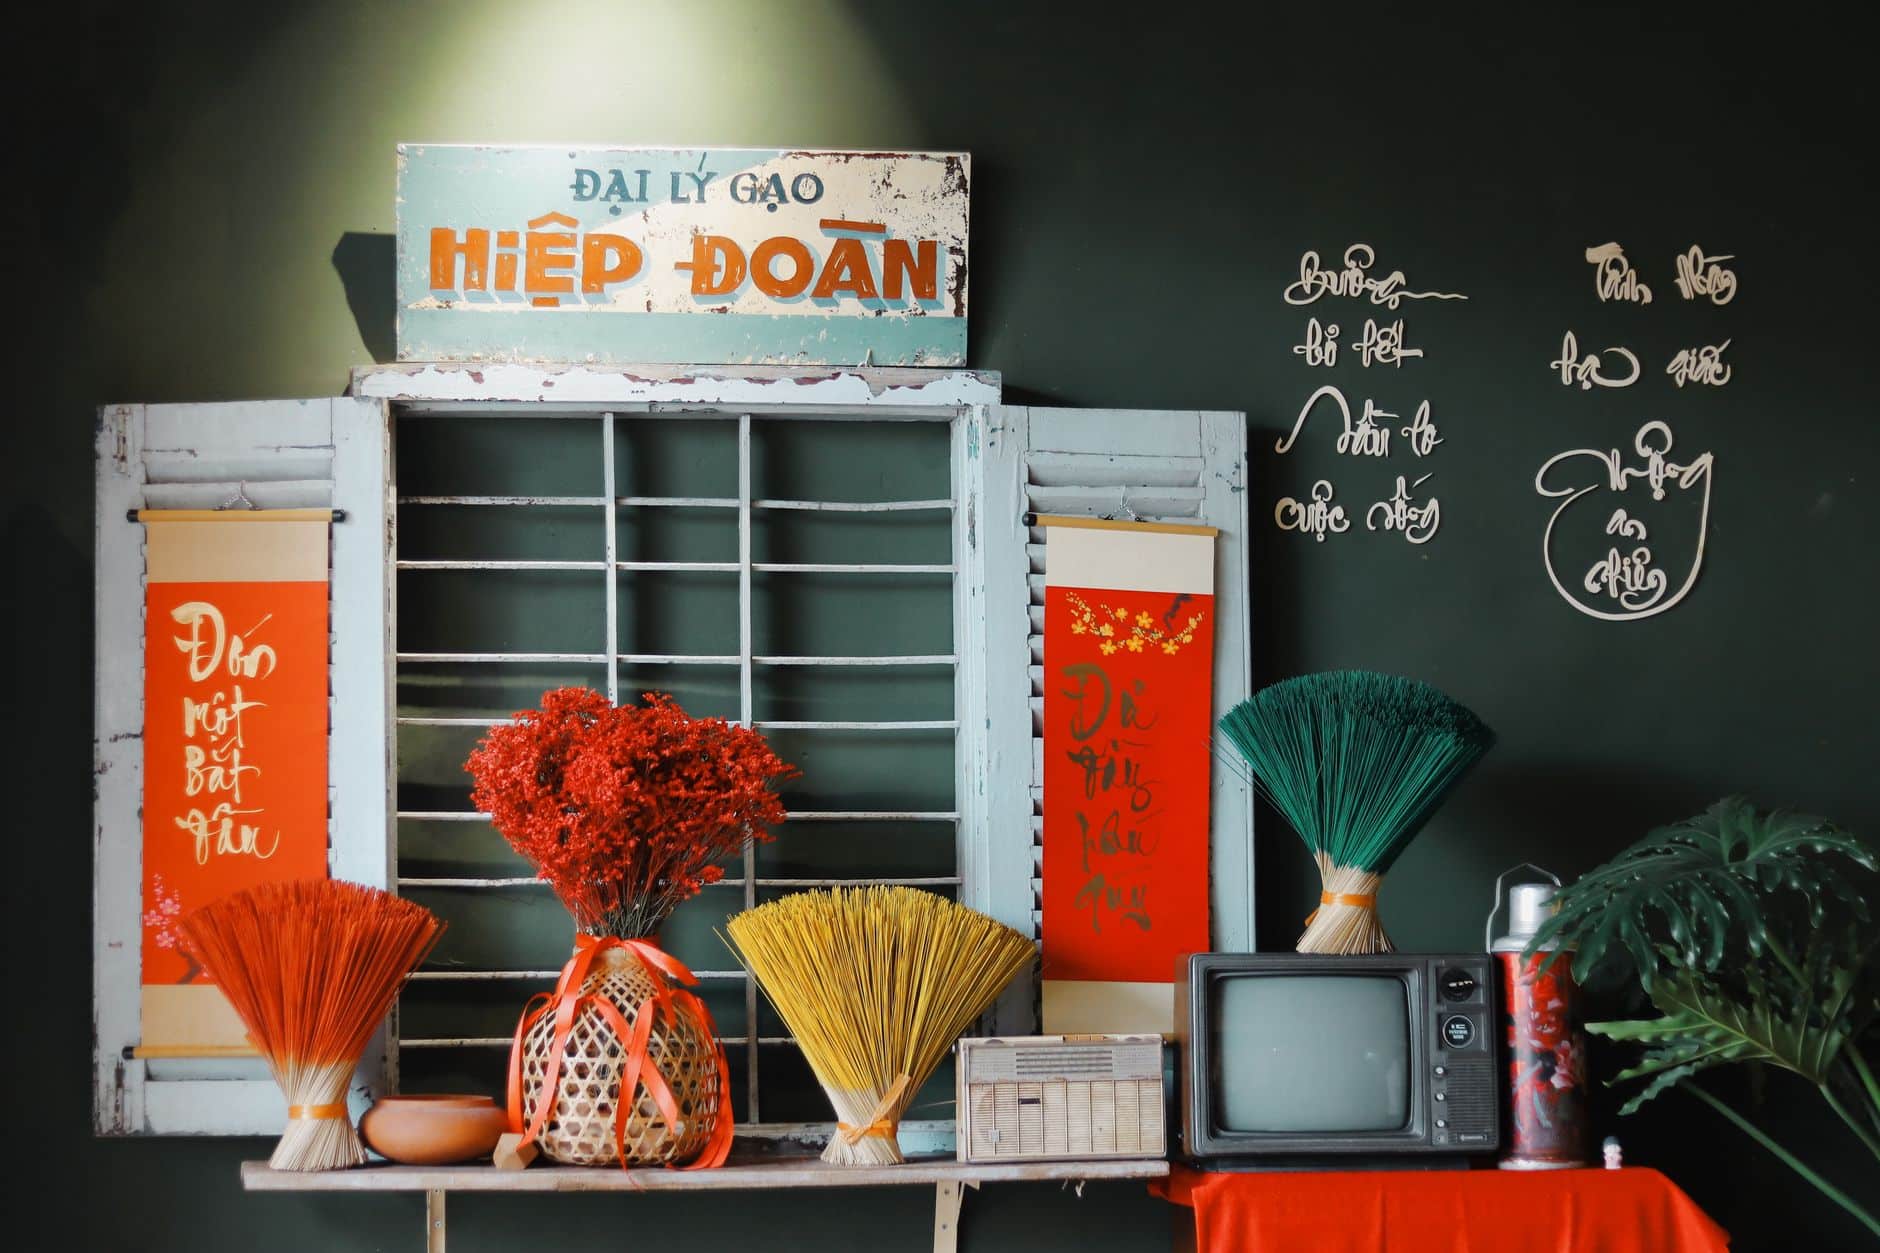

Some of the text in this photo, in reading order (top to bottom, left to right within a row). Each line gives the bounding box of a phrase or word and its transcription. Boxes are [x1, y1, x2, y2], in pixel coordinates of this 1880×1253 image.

[569, 151, 825, 217] ĐẠI LÝ GẠO
[170, 601, 277, 682] Đón
